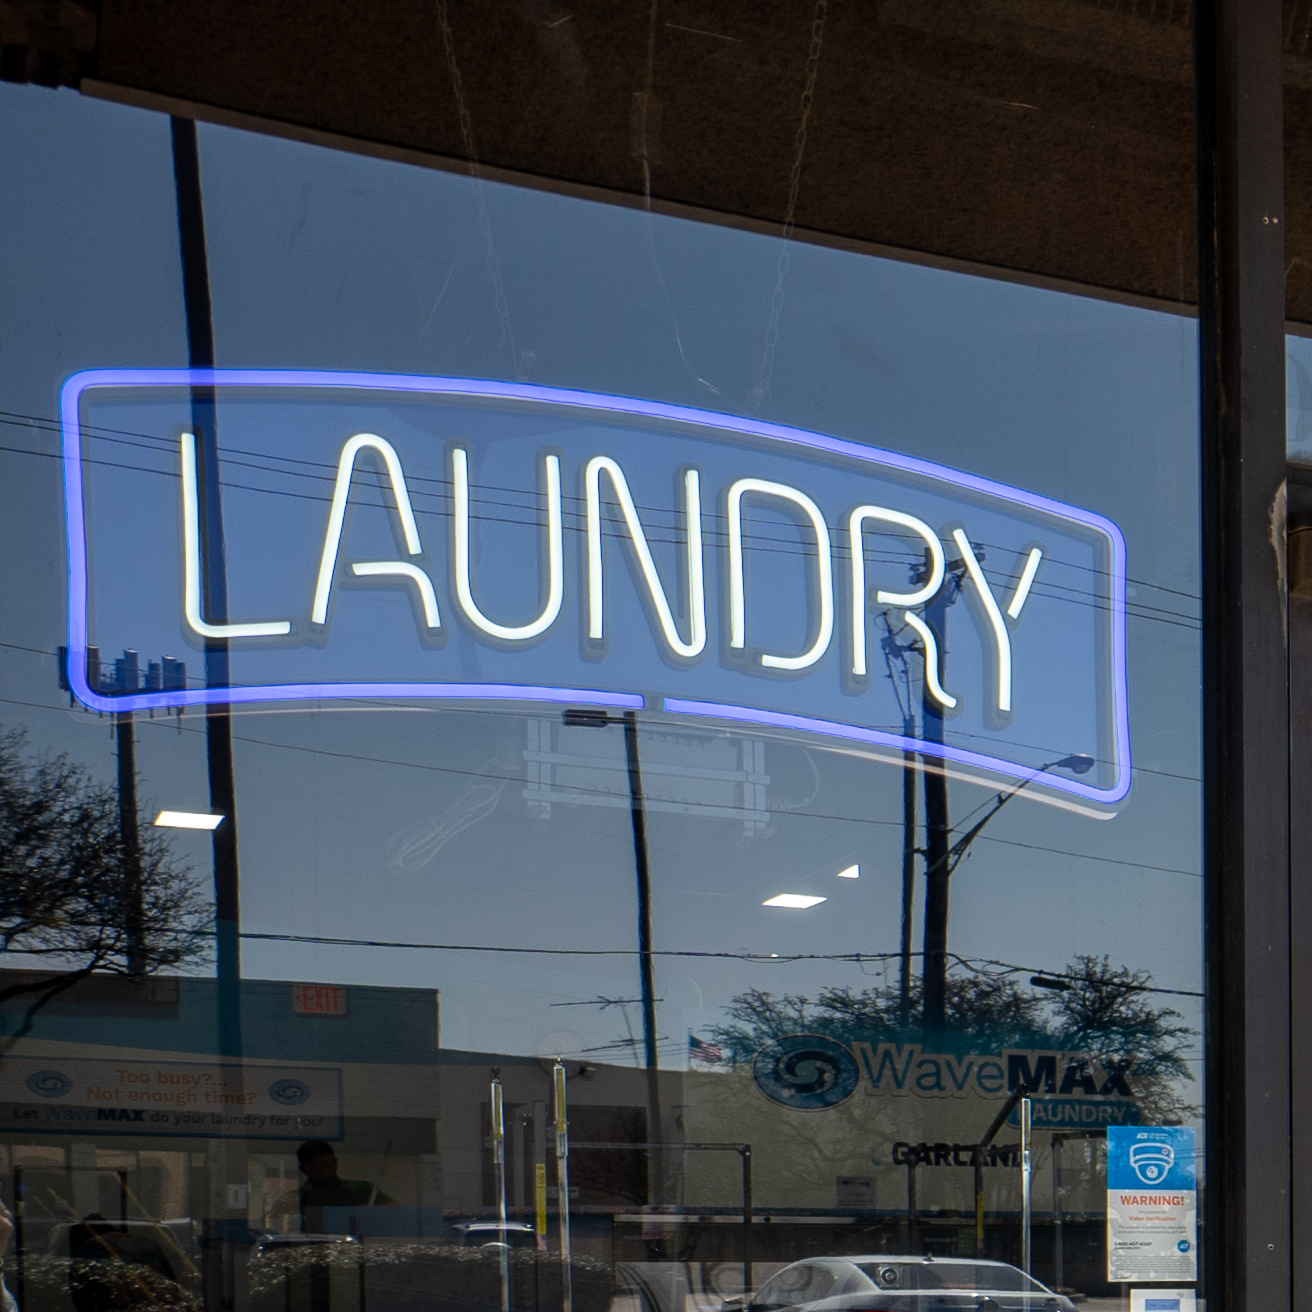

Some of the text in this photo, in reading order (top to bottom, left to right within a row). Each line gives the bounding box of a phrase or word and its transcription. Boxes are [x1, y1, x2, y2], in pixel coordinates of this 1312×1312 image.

[179, 431, 1043, 713] LAUNDRY
[302, 986, 338, 1012] EXIT
[117, 1069, 153, 1084] Too
[860, 1047, 1134, 1096] WaveMAX
[86, 1087, 257, 1106] Not enough time?
[13, 1107, 39, 1120] Let
[44, 1107, 145, 1122] WaveMAX
[151, 1111, 169, 1123] do
[174, 1114, 205, 1126] your
[212, 1112, 267, 1128] laundry
[270, 1115, 291, 1126] for
[1120, 1195, 1185, 1206] WARNING!
